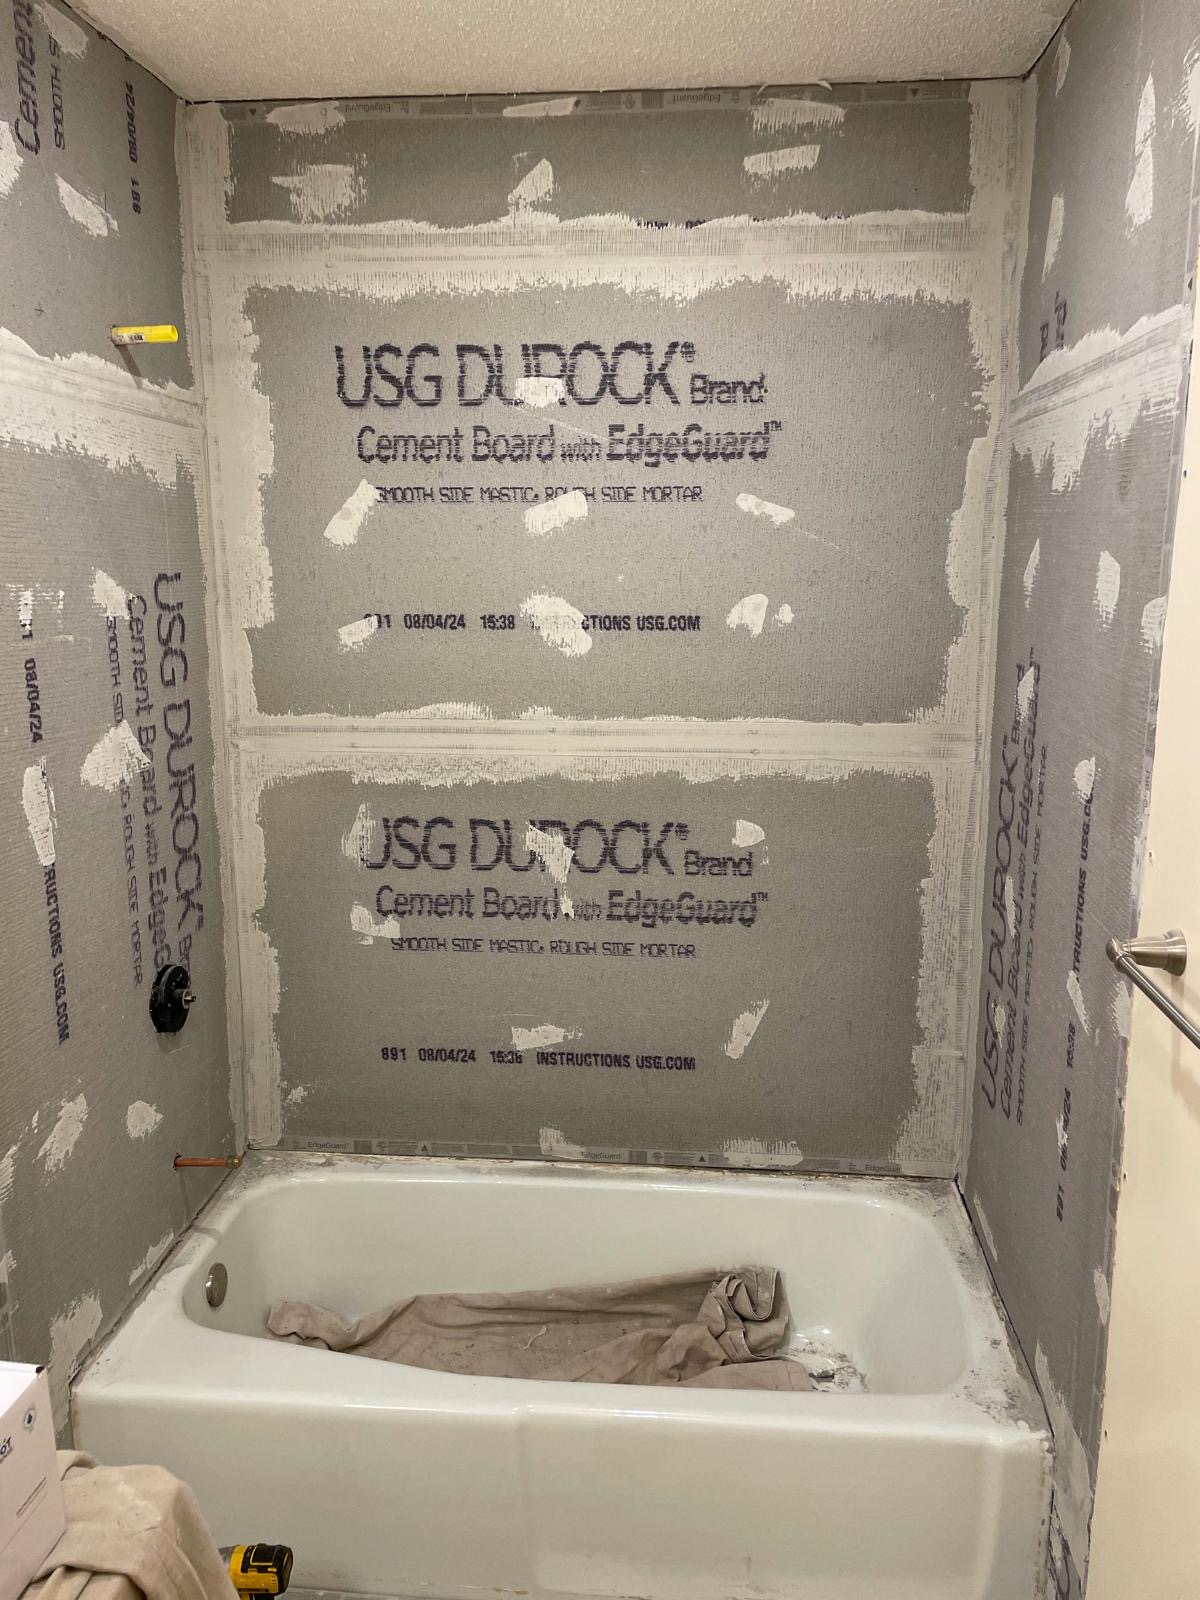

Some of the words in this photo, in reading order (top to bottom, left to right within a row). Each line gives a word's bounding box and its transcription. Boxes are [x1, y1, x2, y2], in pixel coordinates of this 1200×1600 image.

[335, 344, 442, 407] USG
[357, 425, 464, 463] Cement
[472, 424, 554, 463] Board
[560, 435, 606, 462] with
[439, 487, 474, 503] SIDE
[601, 487, 637, 503] SIDE
[643, 487, 703, 503] MORTAR
[154, 571, 190, 688] USG
[403, 614, 466, 630] 08/04/24
[480, 614, 515, 630] 15:38
[636, 615, 701, 631] USG.COM
[126, 595, 154, 717] Cement
[23, 657, 44, 743] 08/04/24
[684, 849, 754, 877] Brand
[376, 885, 475, 918] Cement
[482, 887, 559, 921] Board
[391, 937, 448, 951] SMOOTH
[452, 938, 485, 953] SIDE
[602, 942, 636, 957] SIDE
[640, 943, 697, 958] MORTAR
[52, 962, 70, 1046] USG.COM
[381, 1047, 407, 1061] 891
[418, 1048, 477, 1063] 08/04/24
[537, 1051, 631, 1068] INSTRUCTIONS
[636, 1056, 696, 1071] USG.COM
[1001, 999, 1017, 1120] Cement
